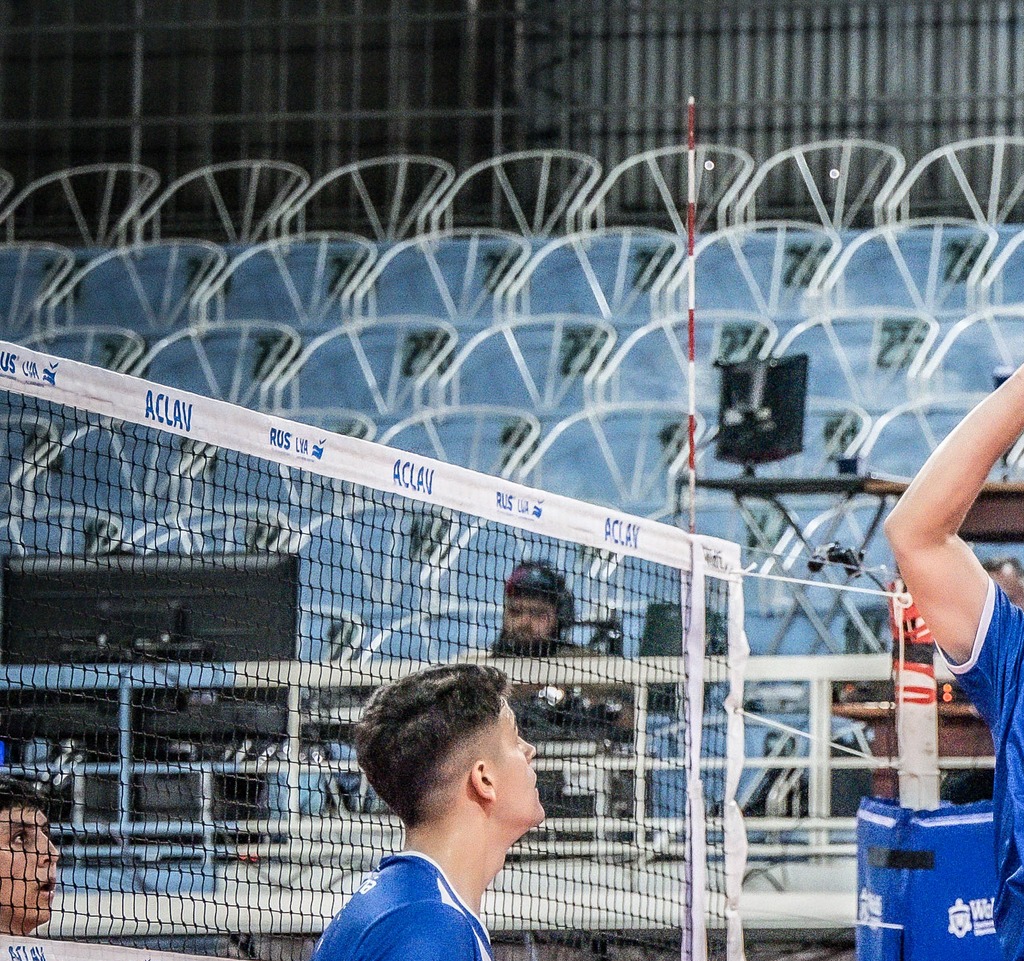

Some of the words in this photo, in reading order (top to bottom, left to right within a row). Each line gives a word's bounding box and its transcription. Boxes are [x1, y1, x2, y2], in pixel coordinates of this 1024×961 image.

[0, 351, 17, 374] US
[145, 390, 192, 432] ACLAV
[269, 427, 292, 450] RUS
[393, 459, 435, 495] ACLAV
[496, 491, 514, 511] RUS
[604, 517, 640, 548] ACLAV
